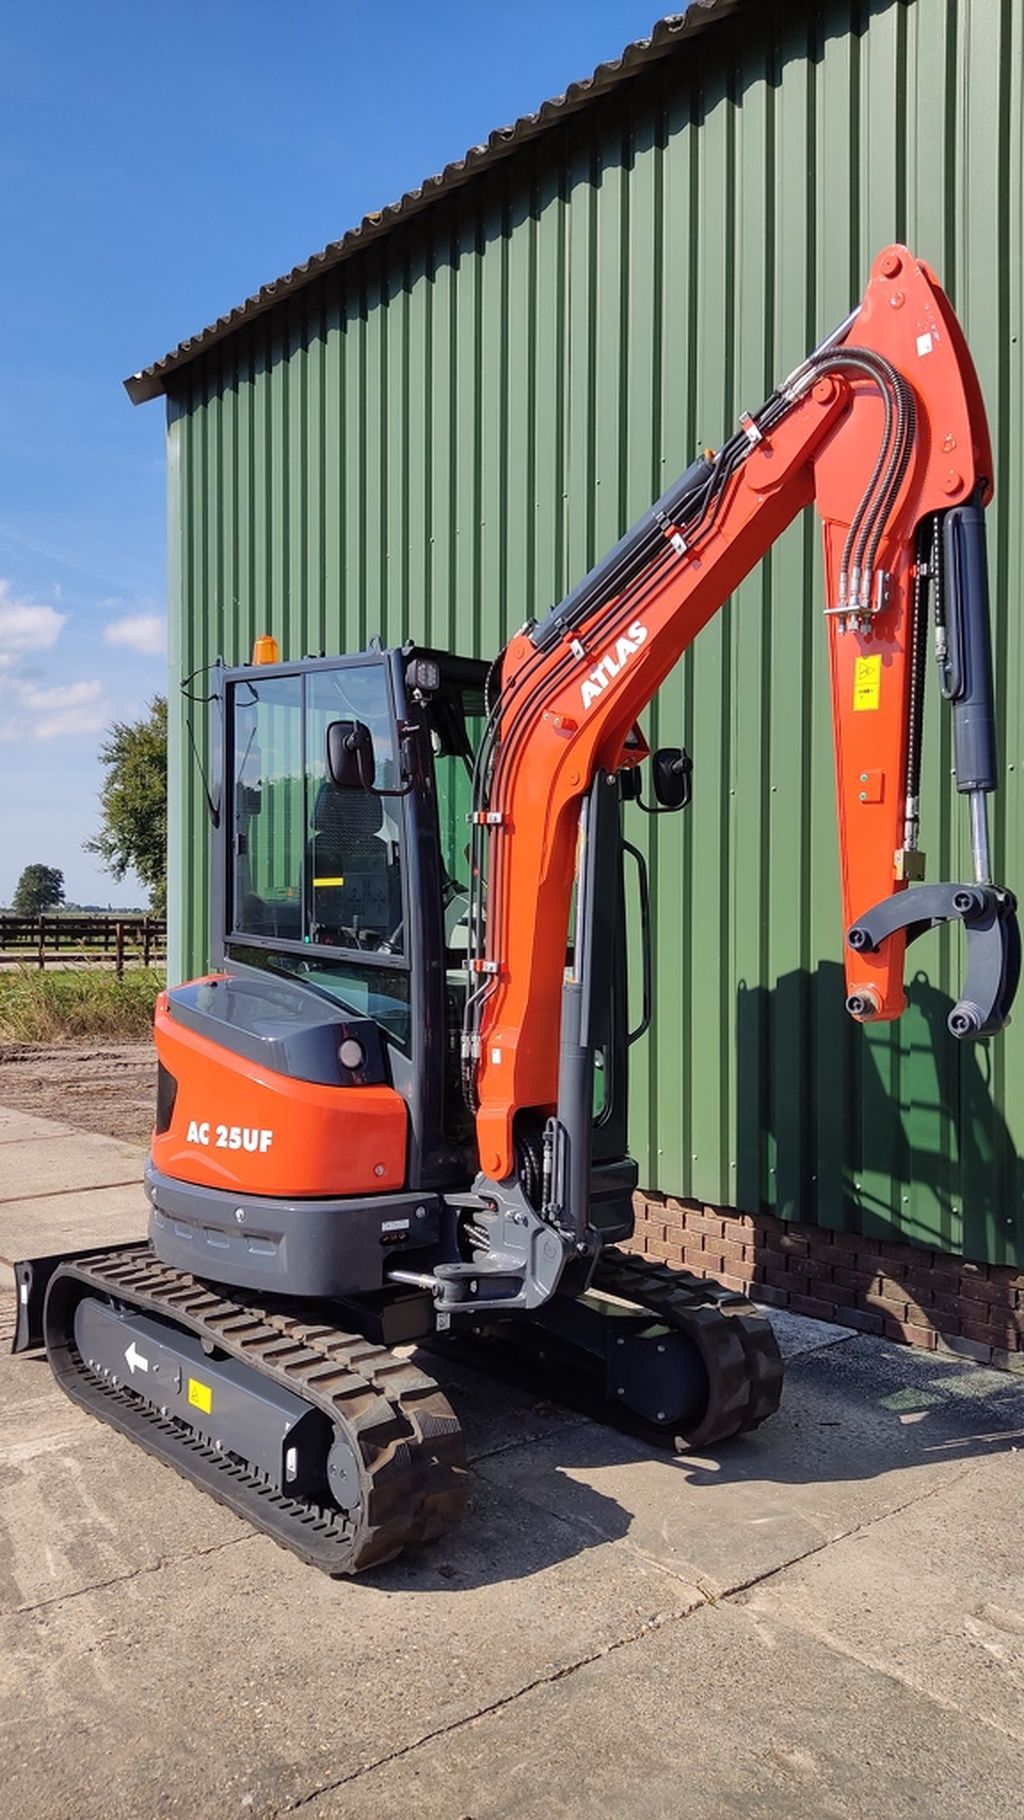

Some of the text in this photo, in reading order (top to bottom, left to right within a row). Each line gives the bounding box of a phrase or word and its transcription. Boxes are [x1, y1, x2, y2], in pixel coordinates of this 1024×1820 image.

[580, 619, 649, 710] ATLAS
[186, 1120, 273, 1152] AC 25UF
